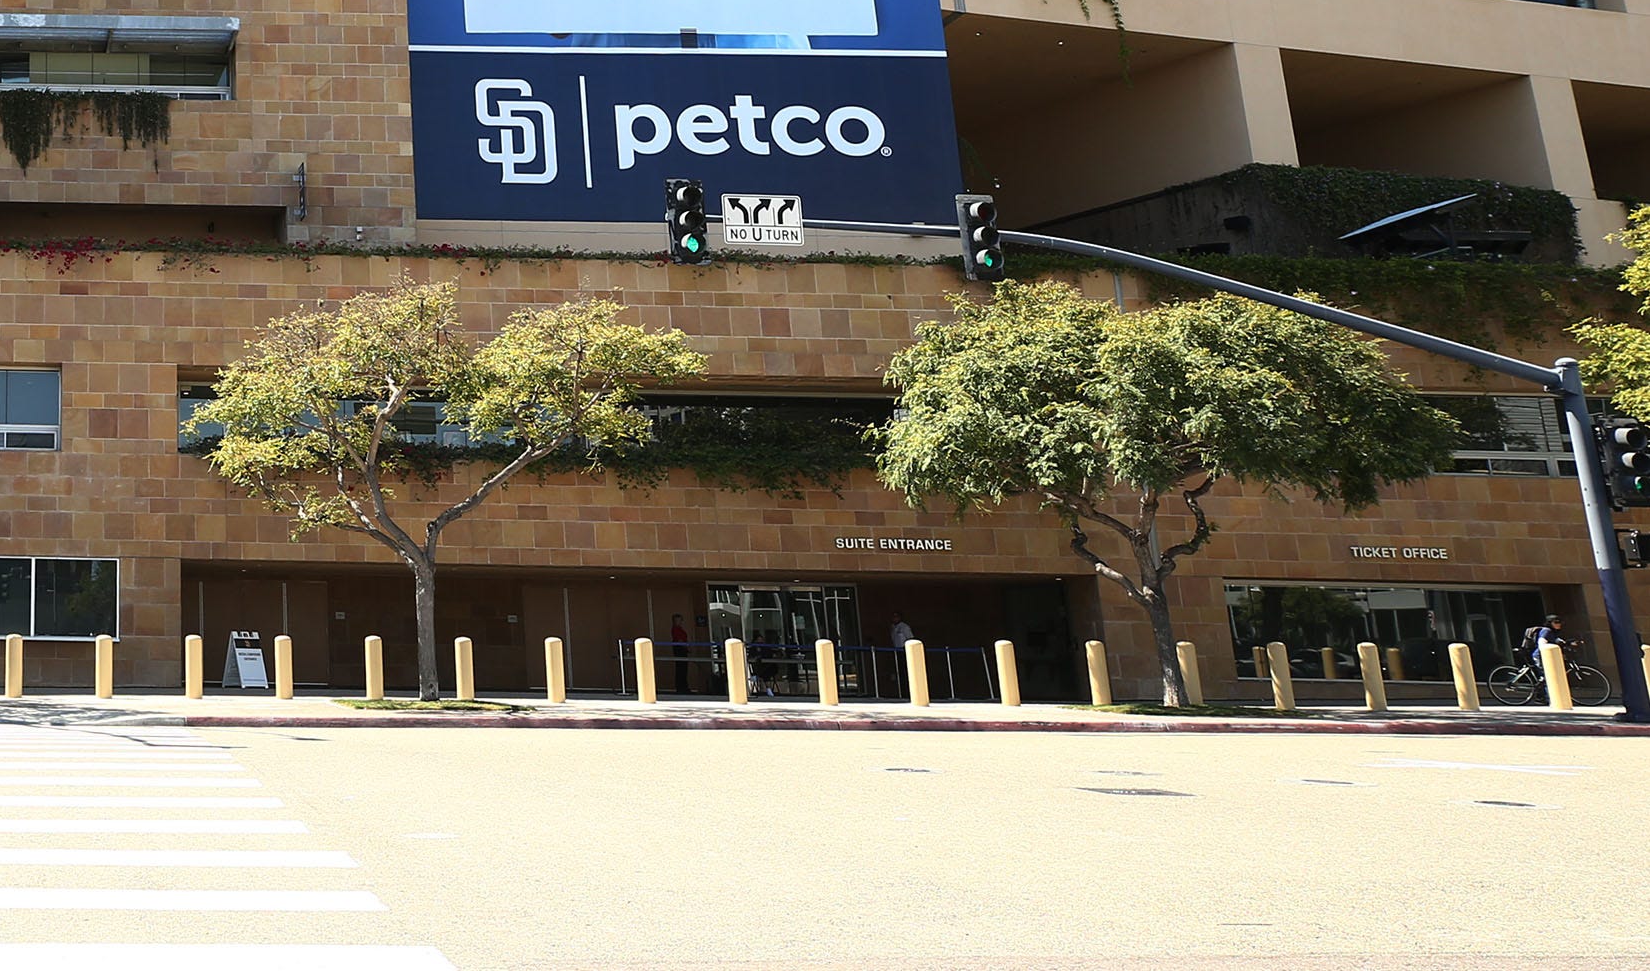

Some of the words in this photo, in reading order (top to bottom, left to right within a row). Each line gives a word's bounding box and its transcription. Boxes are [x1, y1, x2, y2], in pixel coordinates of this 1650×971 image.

[474, 79, 558, 185] SD
[613, 95, 886, 170] petco
[730, 229, 747, 240] NO
[752, 228, 762, 241] U
[766, 230, 799, 241] TURN
[836, 538, 875, 549] SUITE
[879, 538, 952, 550] ENTRANCE
[1350, 546, 1397, 558] TICKET
[1403, 547, 1448, 559] OFFICE
